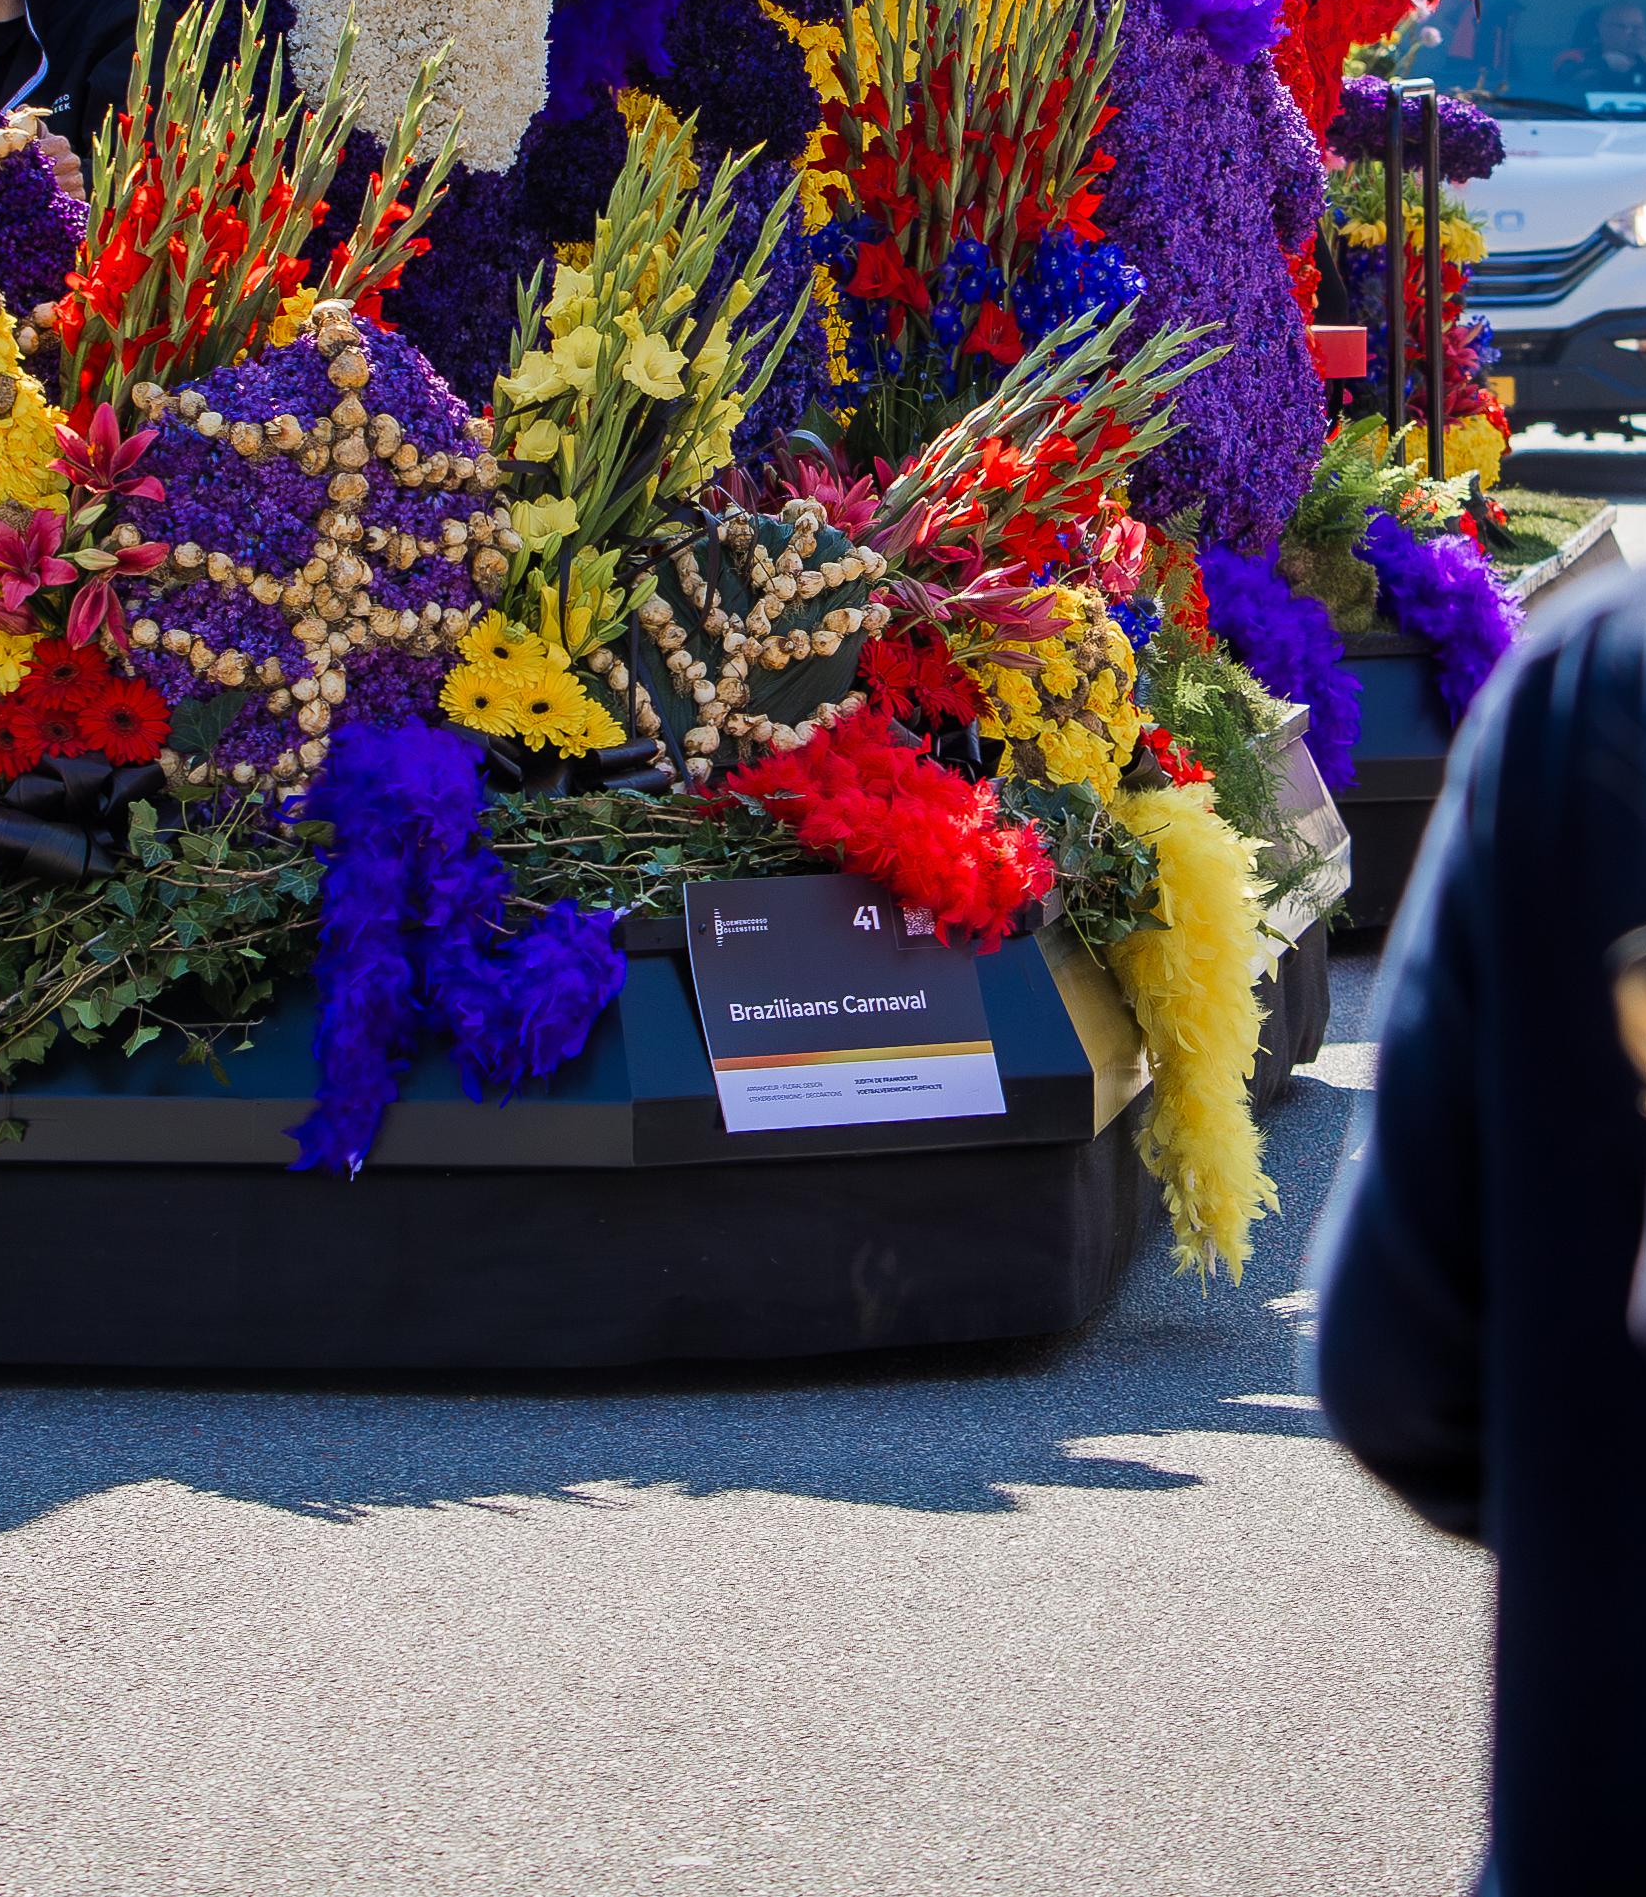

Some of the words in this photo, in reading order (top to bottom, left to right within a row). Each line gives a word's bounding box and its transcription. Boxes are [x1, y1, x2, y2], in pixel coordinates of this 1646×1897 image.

[853, 905, 881, 931] 41
[729, 998, 839, 1022] Braziliaans
[842, 990, 927, 1014] Carnaval
